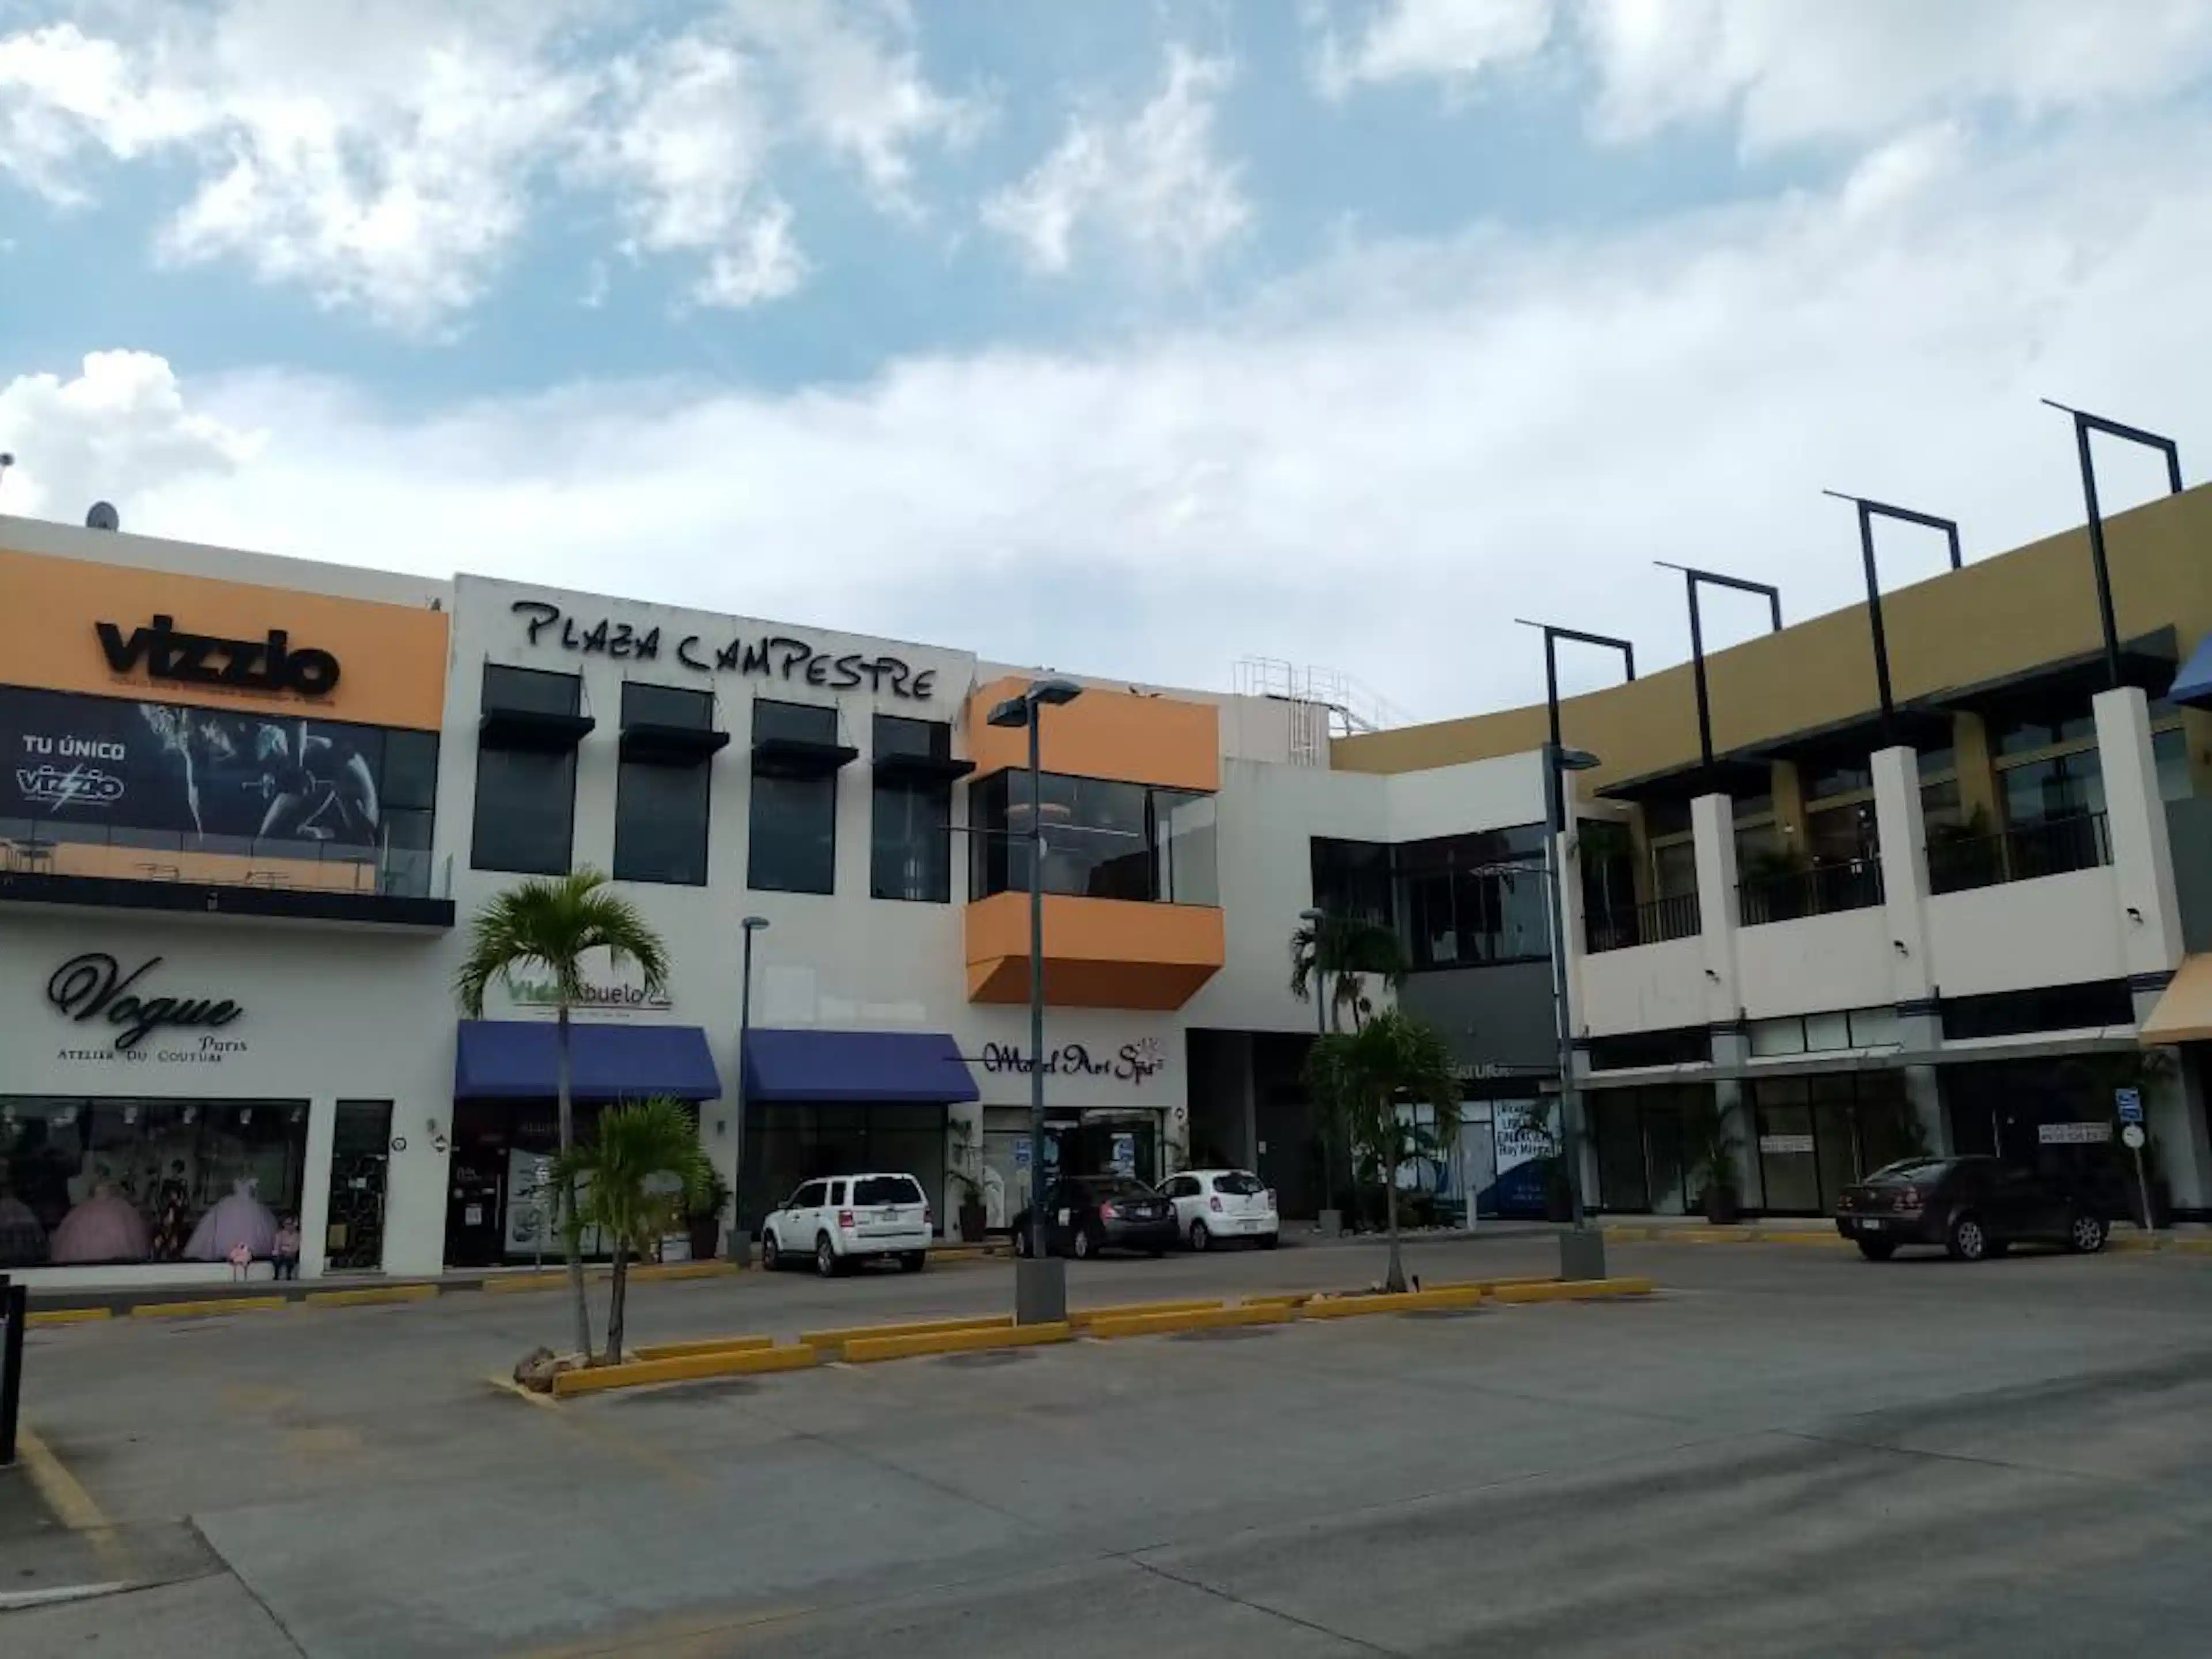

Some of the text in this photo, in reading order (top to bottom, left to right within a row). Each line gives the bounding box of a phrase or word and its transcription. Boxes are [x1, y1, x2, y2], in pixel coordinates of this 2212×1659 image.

[95, 613, 341, 699] vizzio
[512, 601, 938, 701] PLAZA CAMPESTRE
[22, 735, 126, 761] TU ÚNICO
[47, 952, 244, 1051] Vogue
[198, 1035, 248, 1053] Paris
